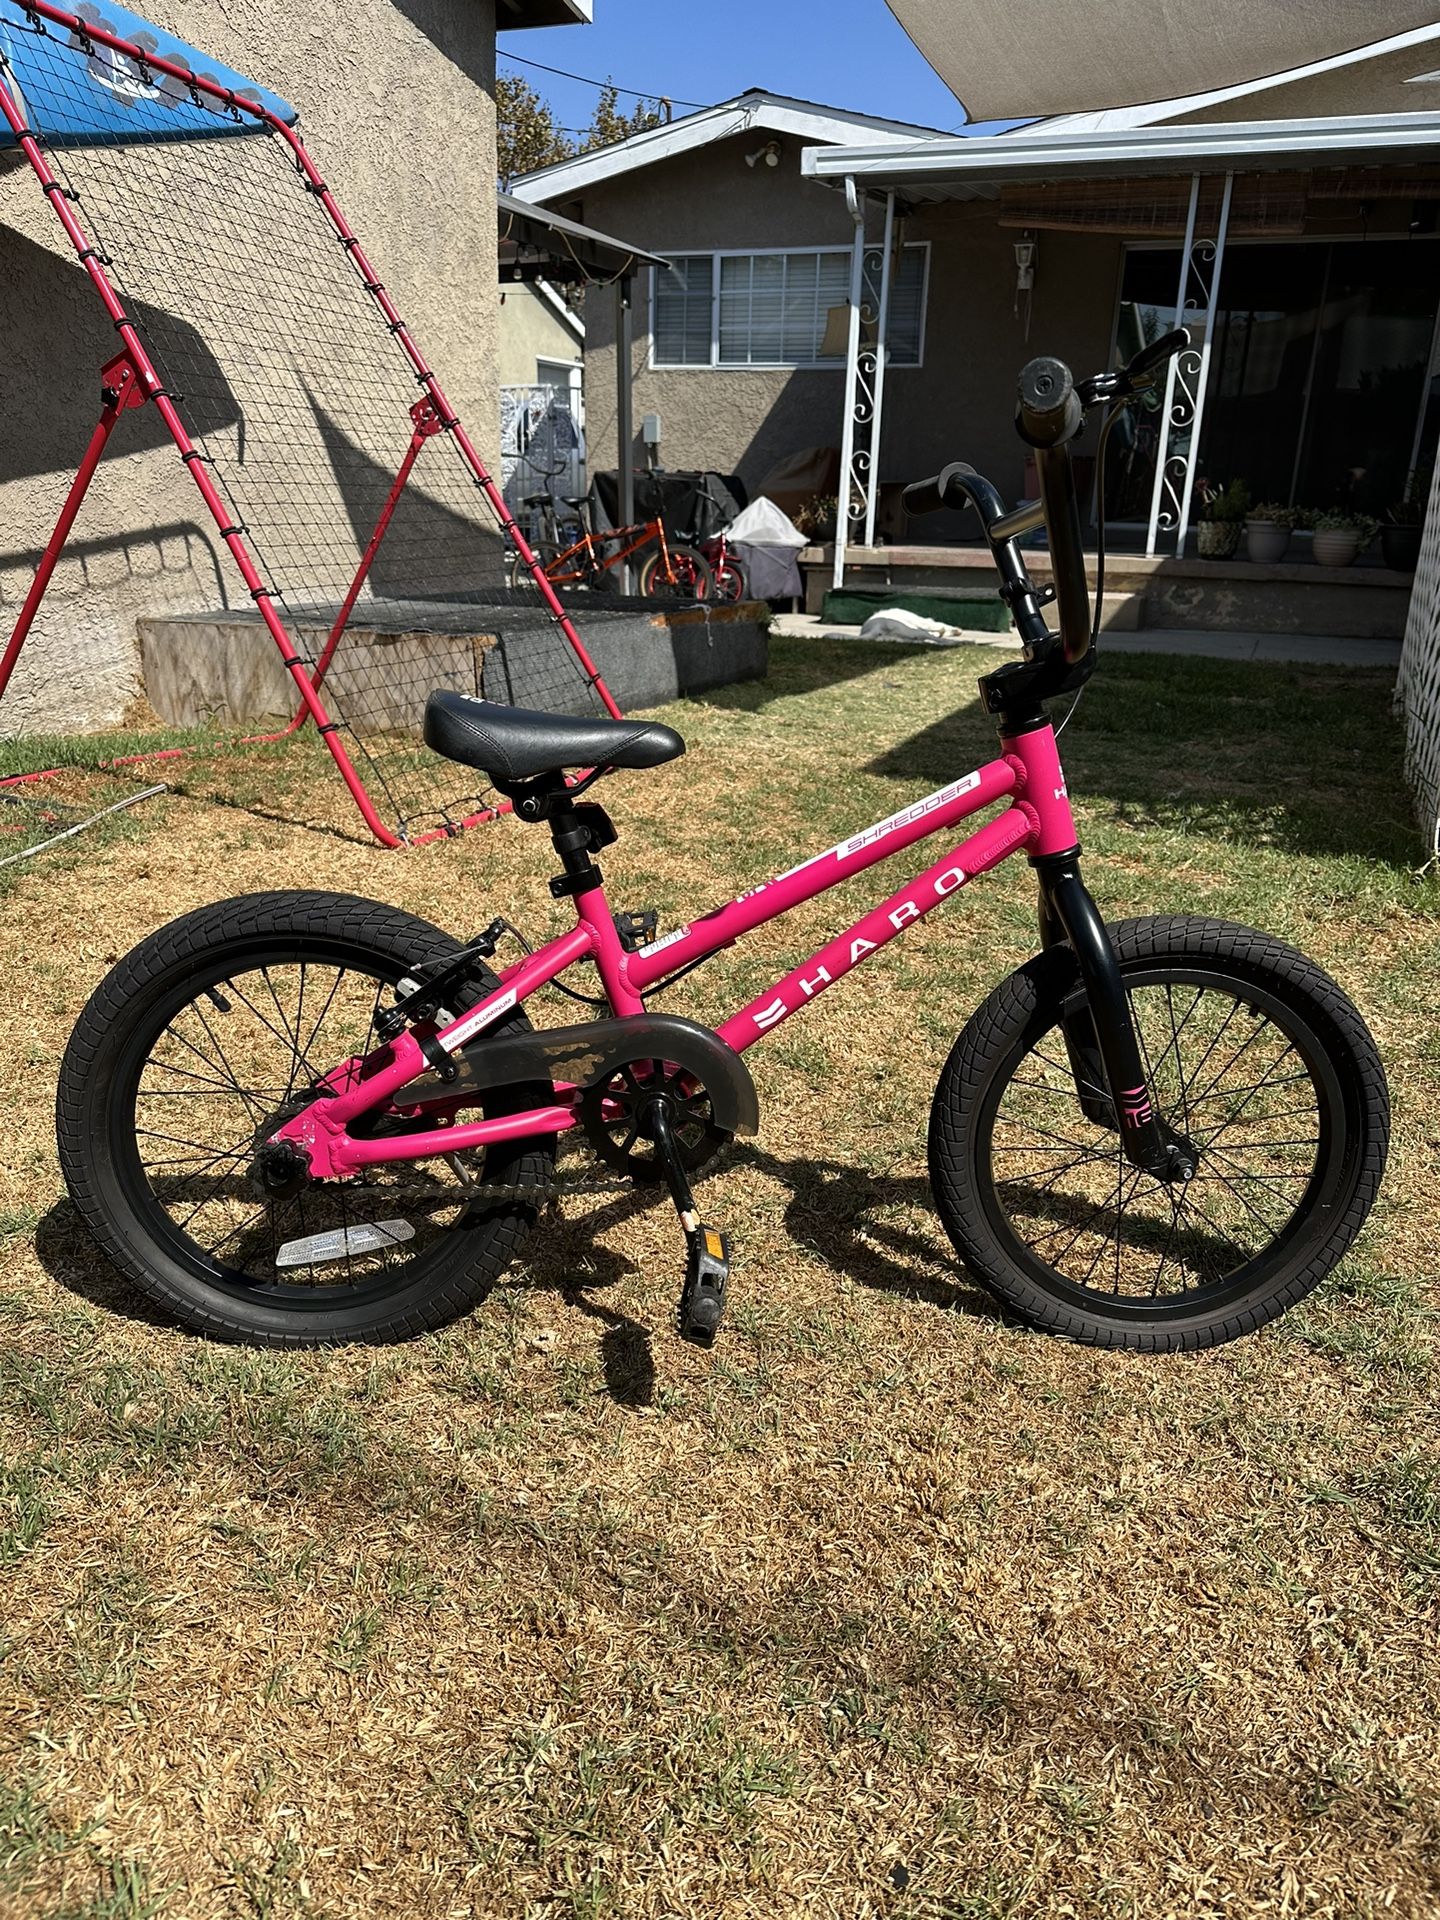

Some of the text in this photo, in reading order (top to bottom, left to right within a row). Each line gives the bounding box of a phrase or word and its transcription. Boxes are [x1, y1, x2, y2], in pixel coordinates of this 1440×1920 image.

[847, 779, 972, 853] SHREDDER
[798, 867, 966, 996] HARO
[474, 998, 512, 1027] ALUMINUM
